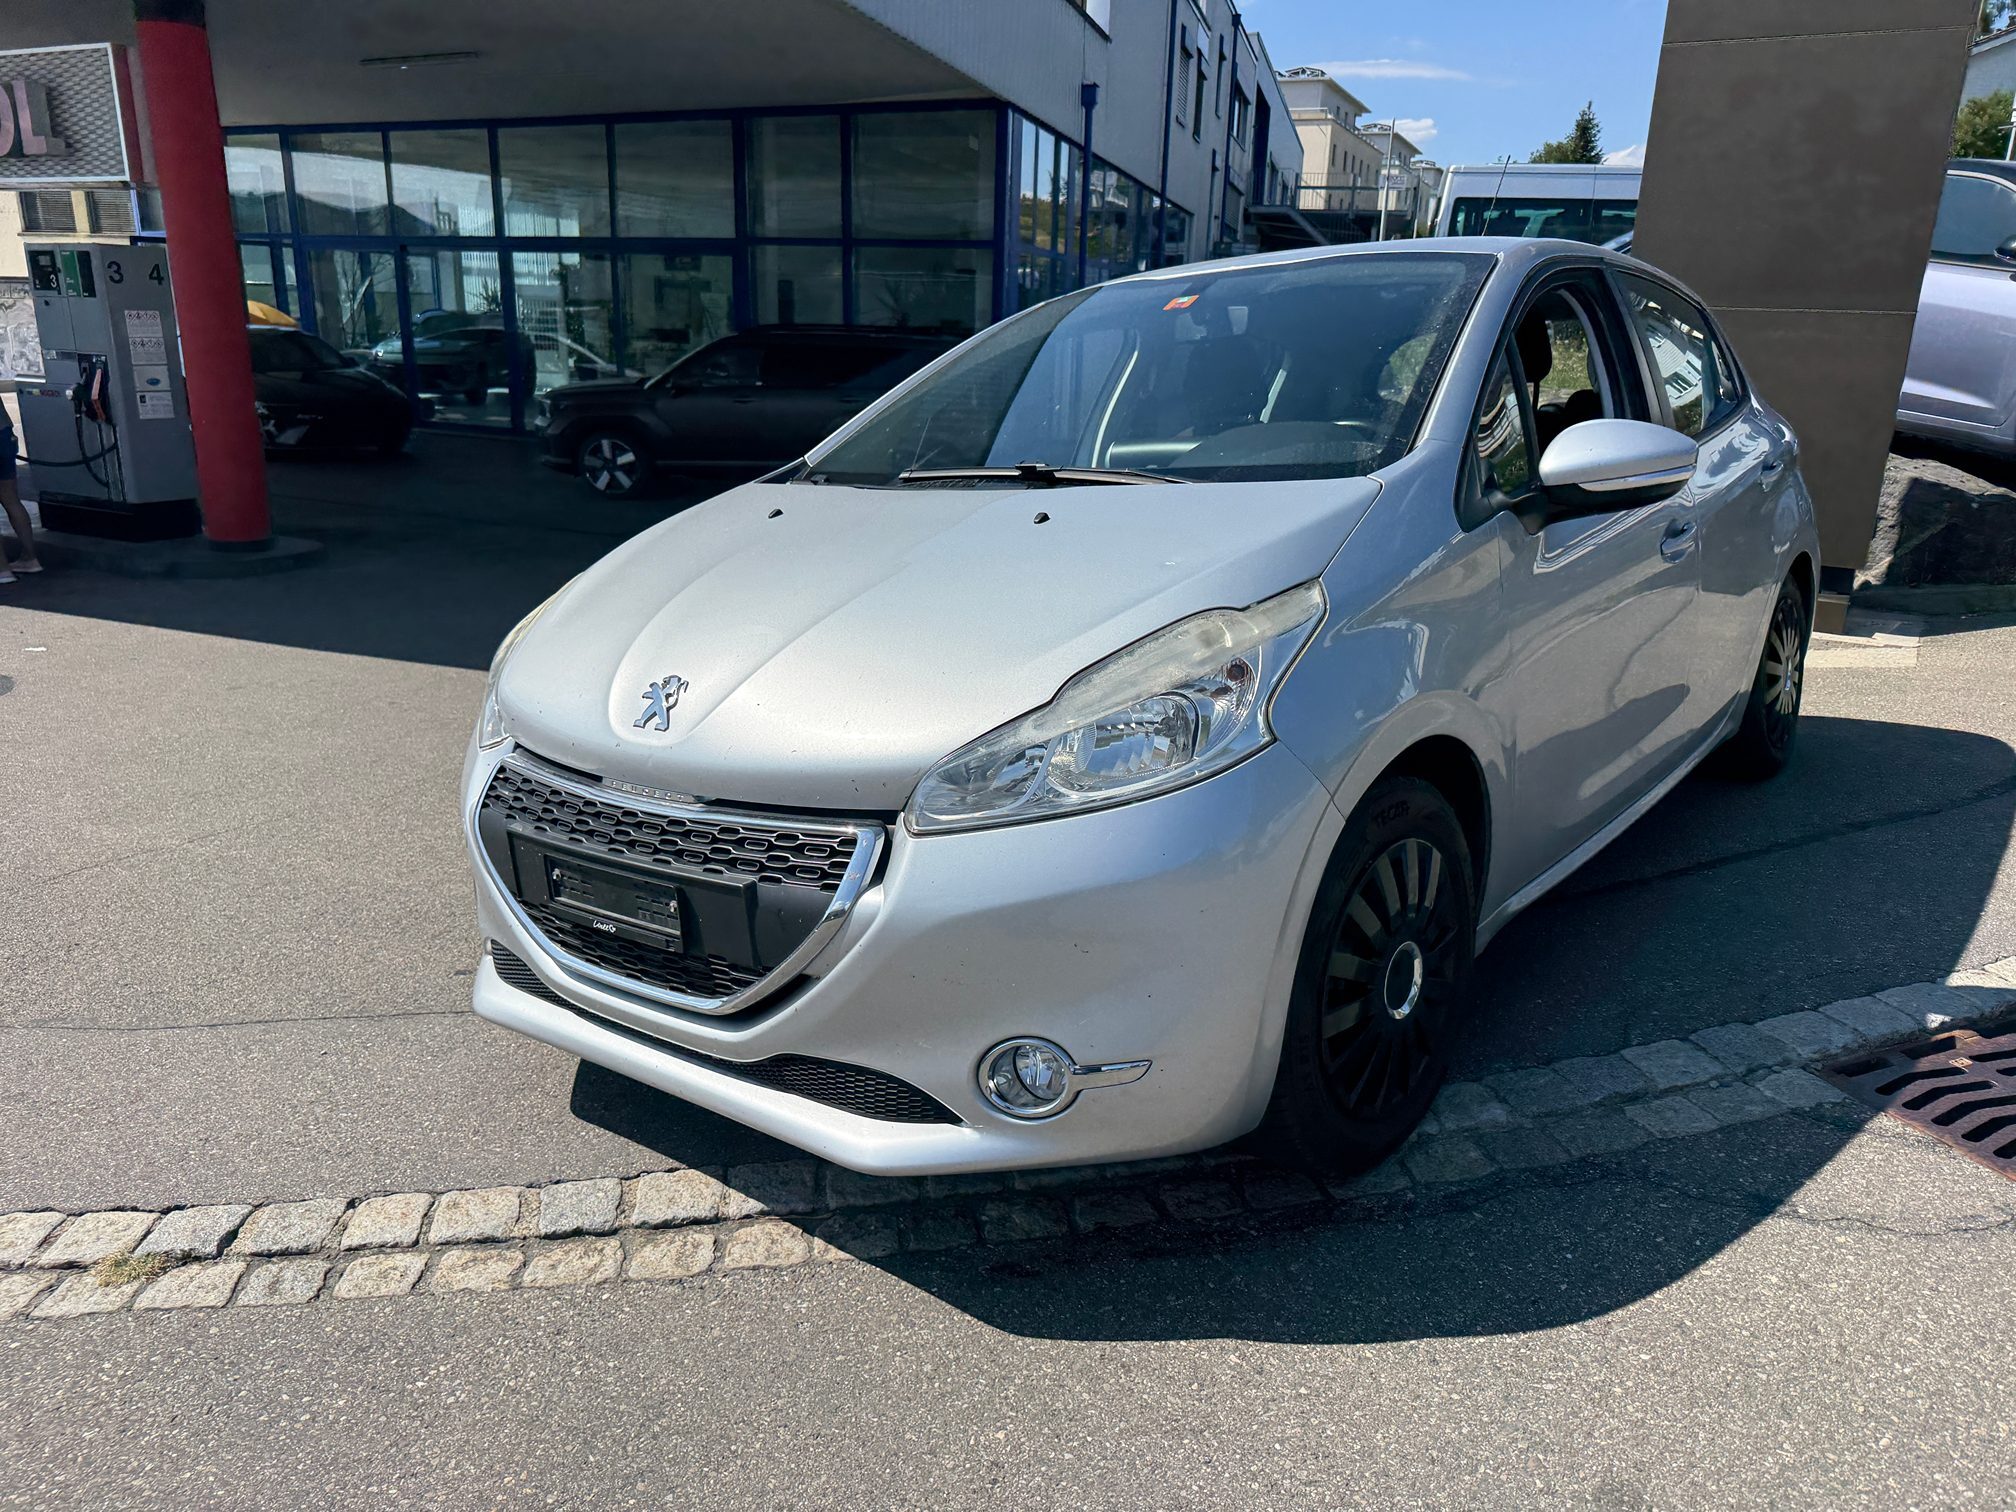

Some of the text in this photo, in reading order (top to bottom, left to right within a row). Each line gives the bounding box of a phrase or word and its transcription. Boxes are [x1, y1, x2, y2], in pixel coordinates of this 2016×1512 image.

[50, 274, 57, 288] 3
[107, 261, 164, 286] 3 4
[611, 781, 684, 802] PEUGEOT
